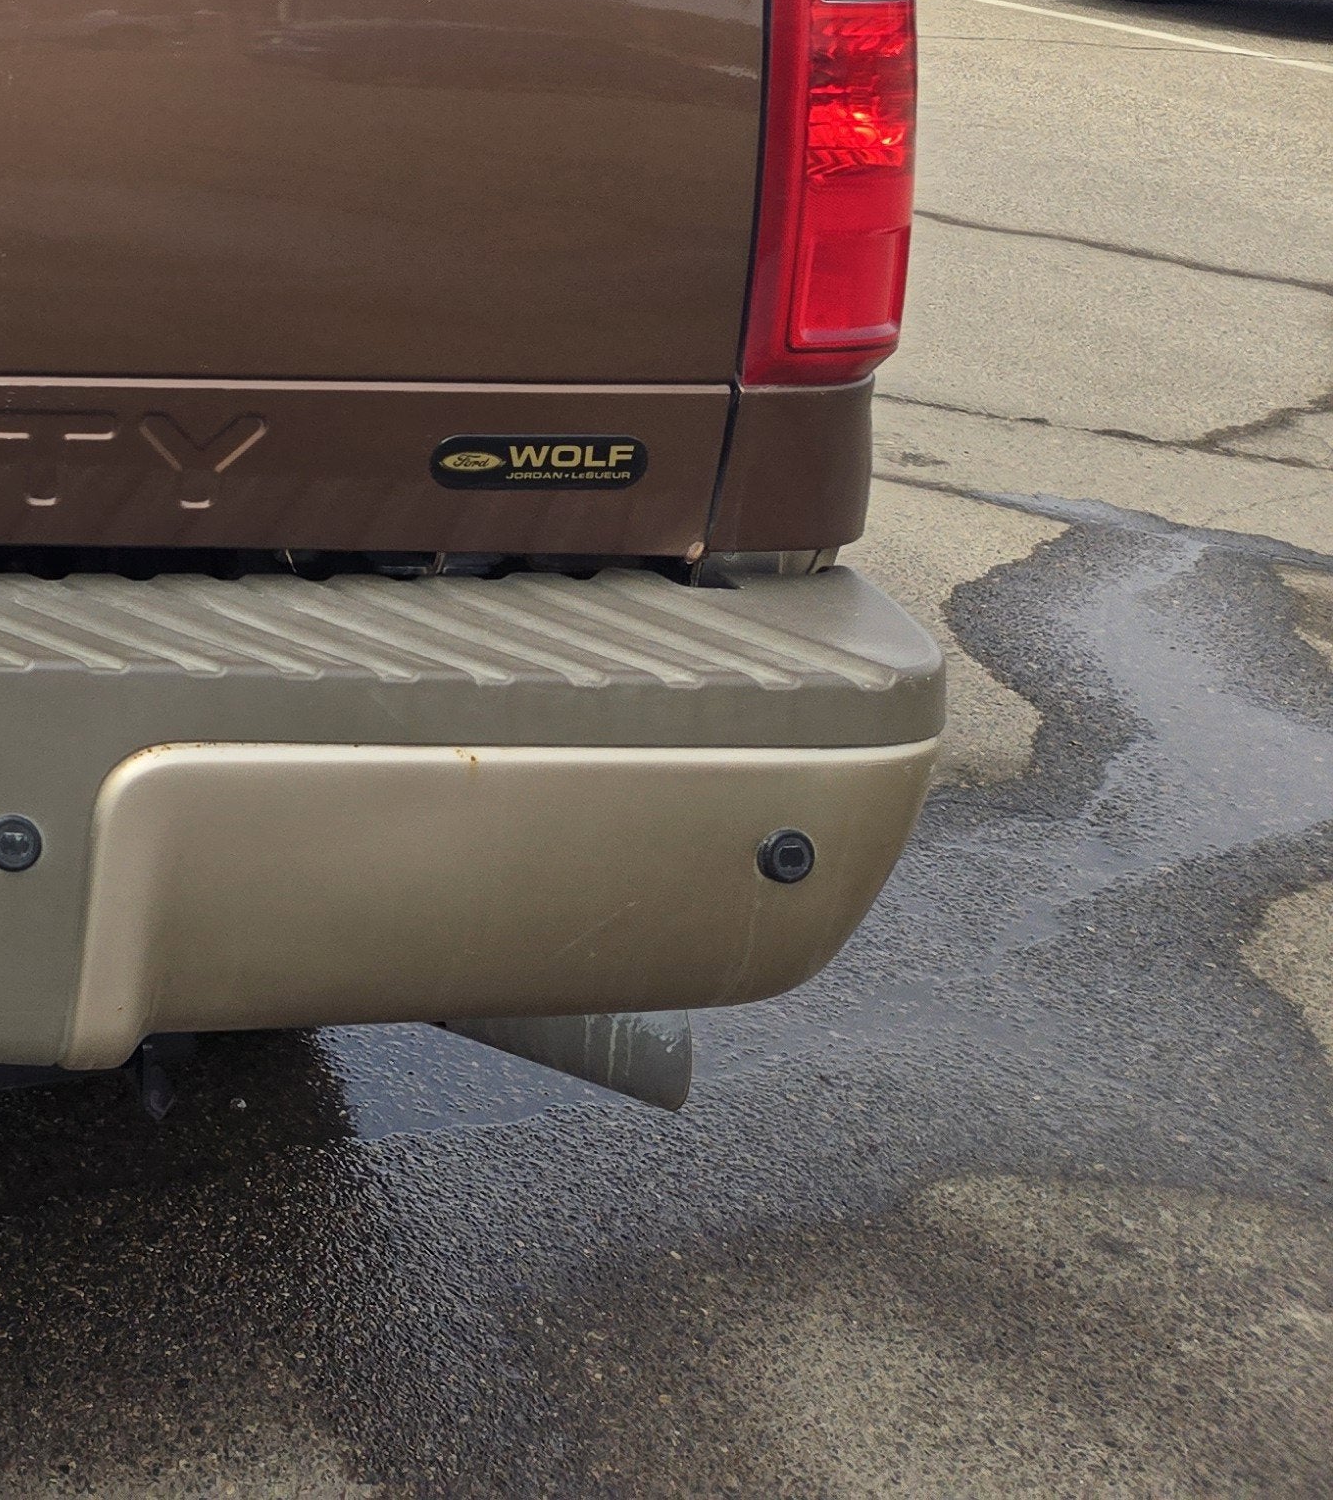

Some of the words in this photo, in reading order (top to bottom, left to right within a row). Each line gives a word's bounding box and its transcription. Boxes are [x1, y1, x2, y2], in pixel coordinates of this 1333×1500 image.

[453, 453, 491, 468] Ford
[508, 445, 635, 468] WOLF
[505, 471, 563, 480] JORDAN
